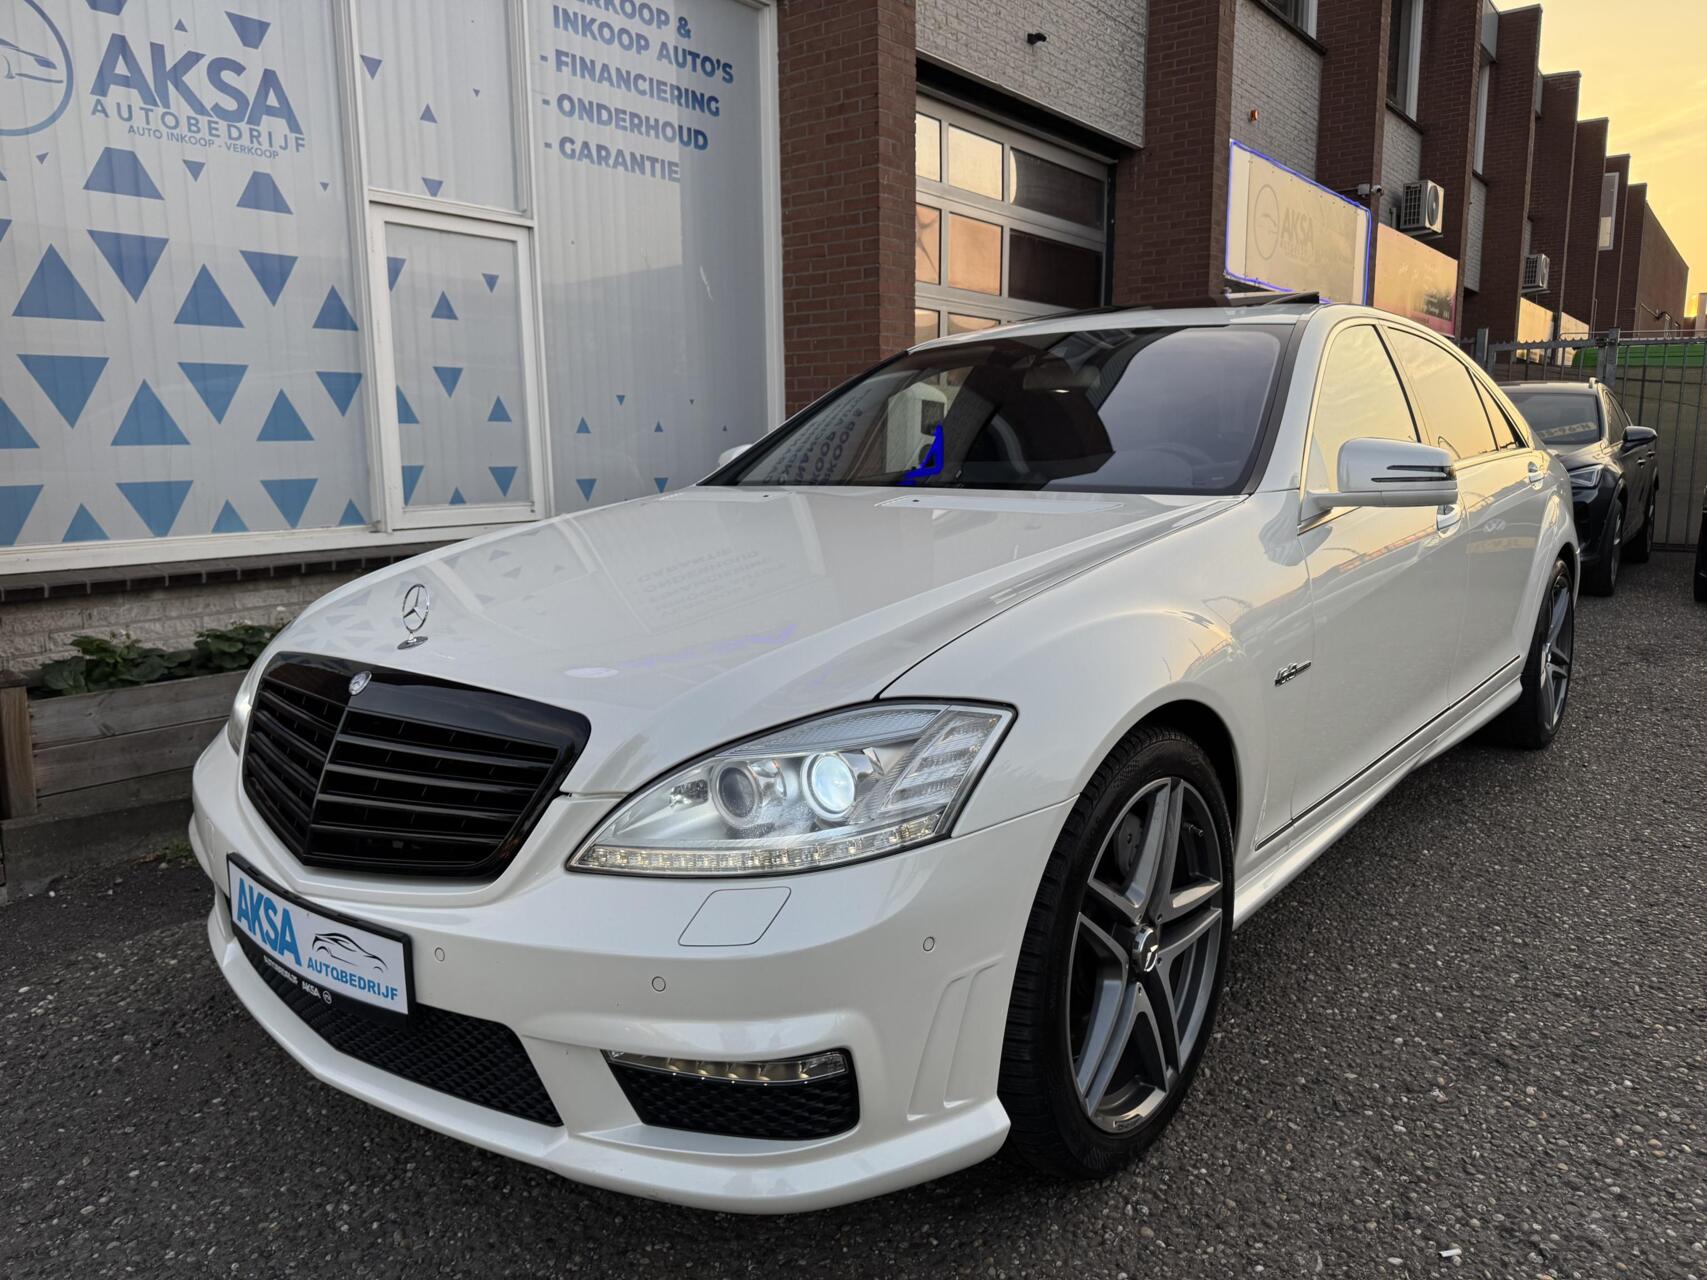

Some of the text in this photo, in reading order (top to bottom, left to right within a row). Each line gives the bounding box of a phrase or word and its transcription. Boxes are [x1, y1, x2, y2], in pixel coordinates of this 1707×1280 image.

[553, 5, 734, 84] INKOOP AUTO'S
[677, 16, 692, 40] &
[90, 33, 304, 135] AKSA
[554, 49, 720, 117] FINANCIERING
[91, 98, 305, 153] AUTOBEDRIJF
[128, 124, 163, 140] AUTO
[166, 131, 214, 148] INKOOP
[225, 142, 279, 160] VERKOOP
[556, 93, 709, 151] ONDERHOUD
[559, 136, 681, 183] GARANTIE
[1280, 207, 1314, 257] AKSA
[237, 877, 302, 967] AKSA
[307, 956, 398, 1001] AUTOBEDRIJF
